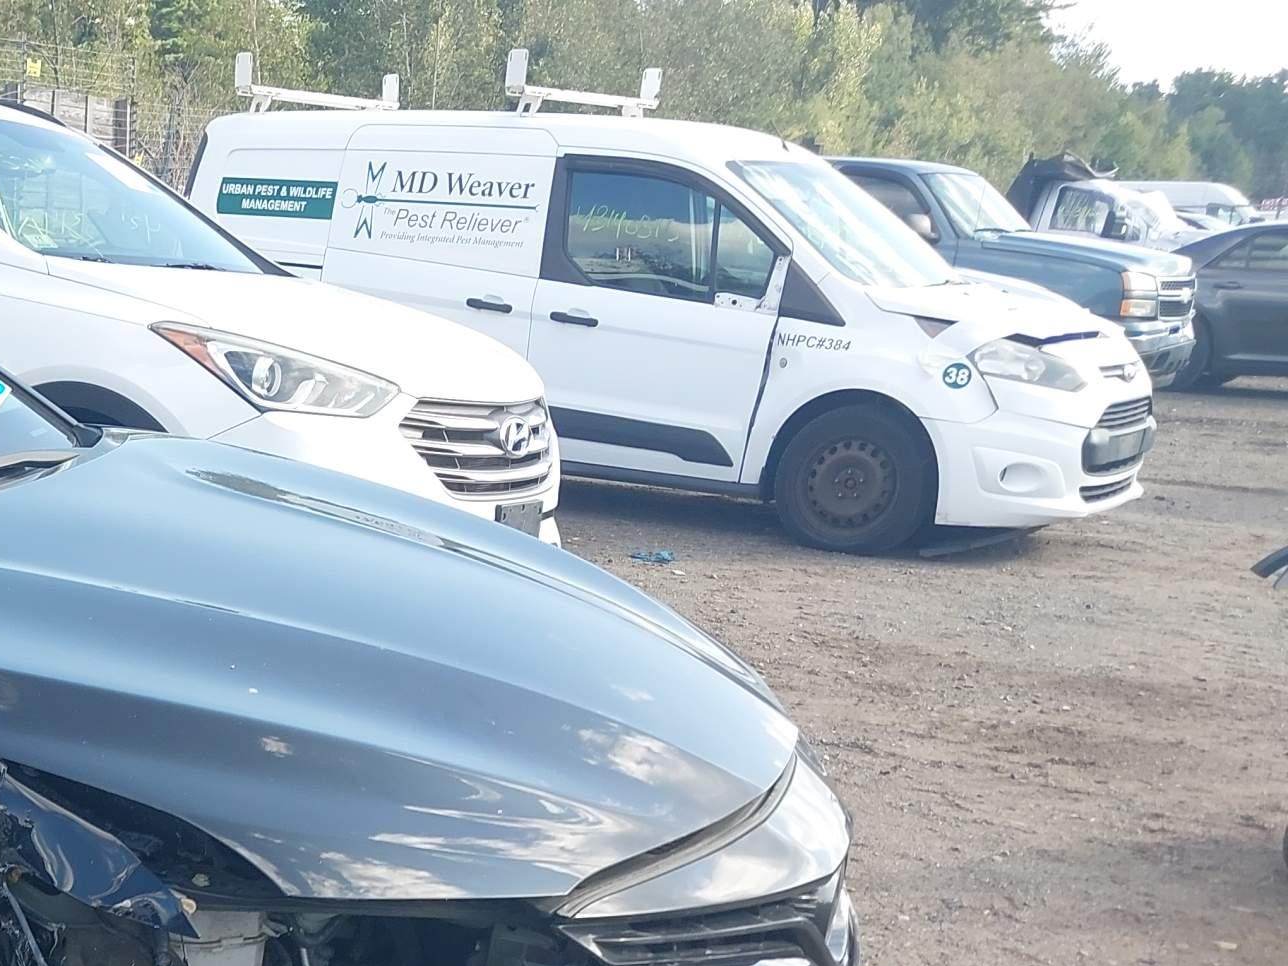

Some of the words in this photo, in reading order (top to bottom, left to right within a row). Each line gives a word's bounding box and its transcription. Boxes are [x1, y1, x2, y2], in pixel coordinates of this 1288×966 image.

[221, 183, 254, 195] URBAN
[255, 185, 280, 196] PEST
[280, 186, 288, 197] &
[289, 186, 333, 199] WILDLIFE
[391, 169, 439, 194] MD
[446, 171, 536, 199] Weaver
[241, 198, 307, 212] MANAGEMENT
[383, 207, 396, 216] The
[393, 208, 437, 229] Pest
[440, 210, 523, 234] Reliever
[380, 231, 415, 244] Providing
[416, 233, 455, 245] Integrated
[456, 236, 472, 245] Pest
[472, 237, 525, 249] Management
[777, 332, 852, 351] NHPC#384
[944, 367, 970, 385] 38
